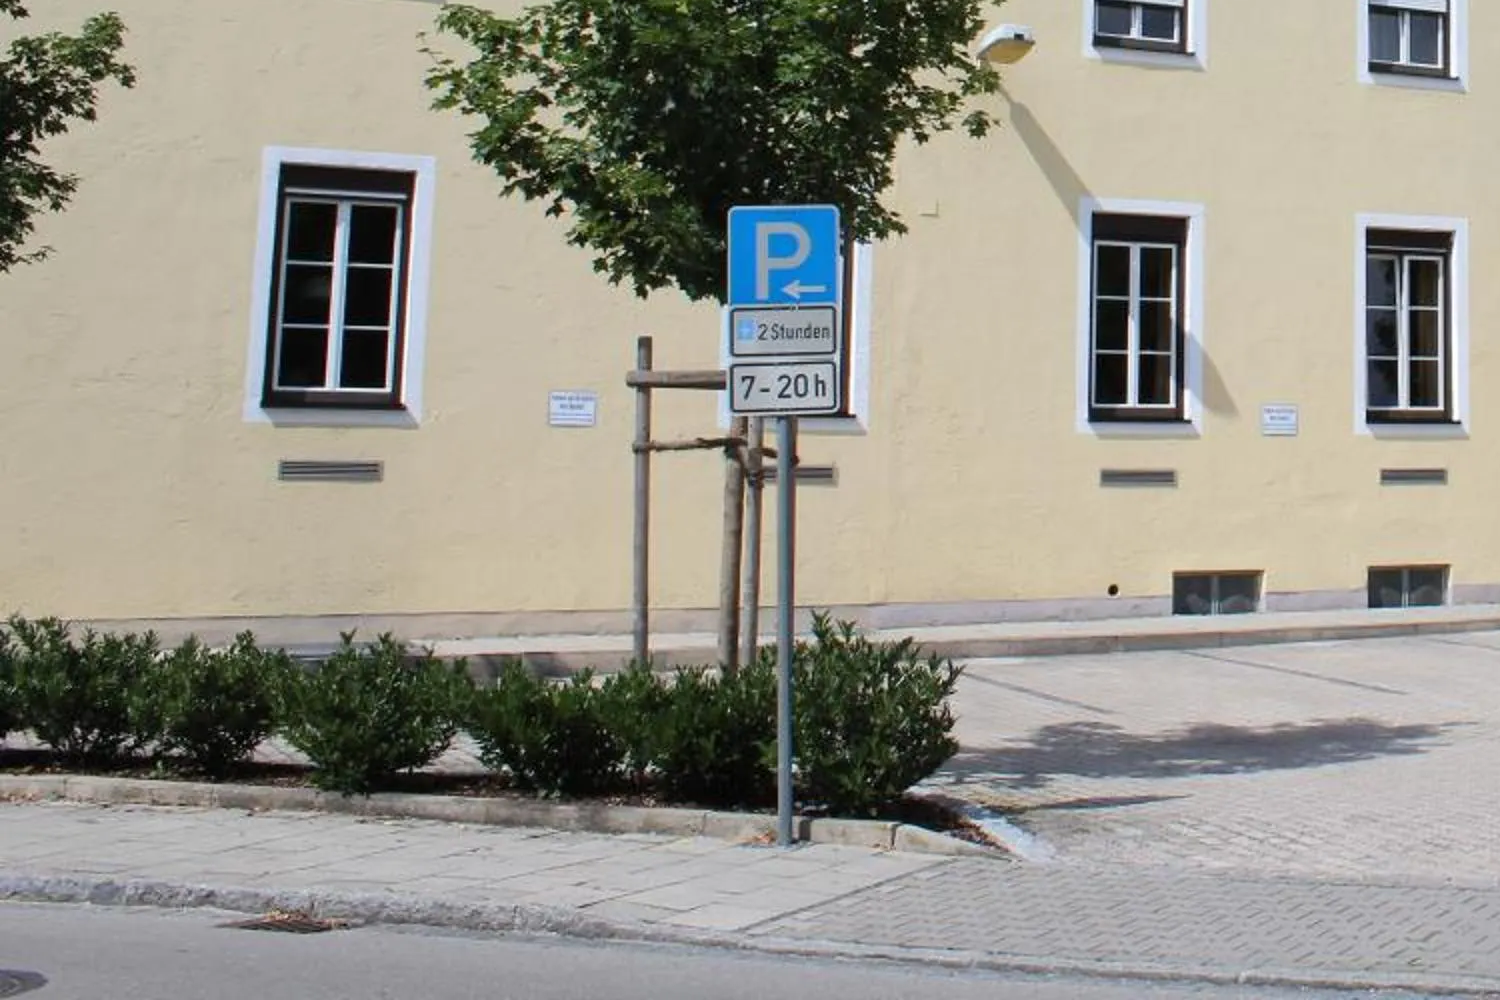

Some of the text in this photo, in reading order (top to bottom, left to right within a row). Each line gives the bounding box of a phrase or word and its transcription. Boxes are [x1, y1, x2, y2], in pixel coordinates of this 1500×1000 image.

[755, 220, 812, 300] P
[757, 322, 831, 341] 2 Stunden
